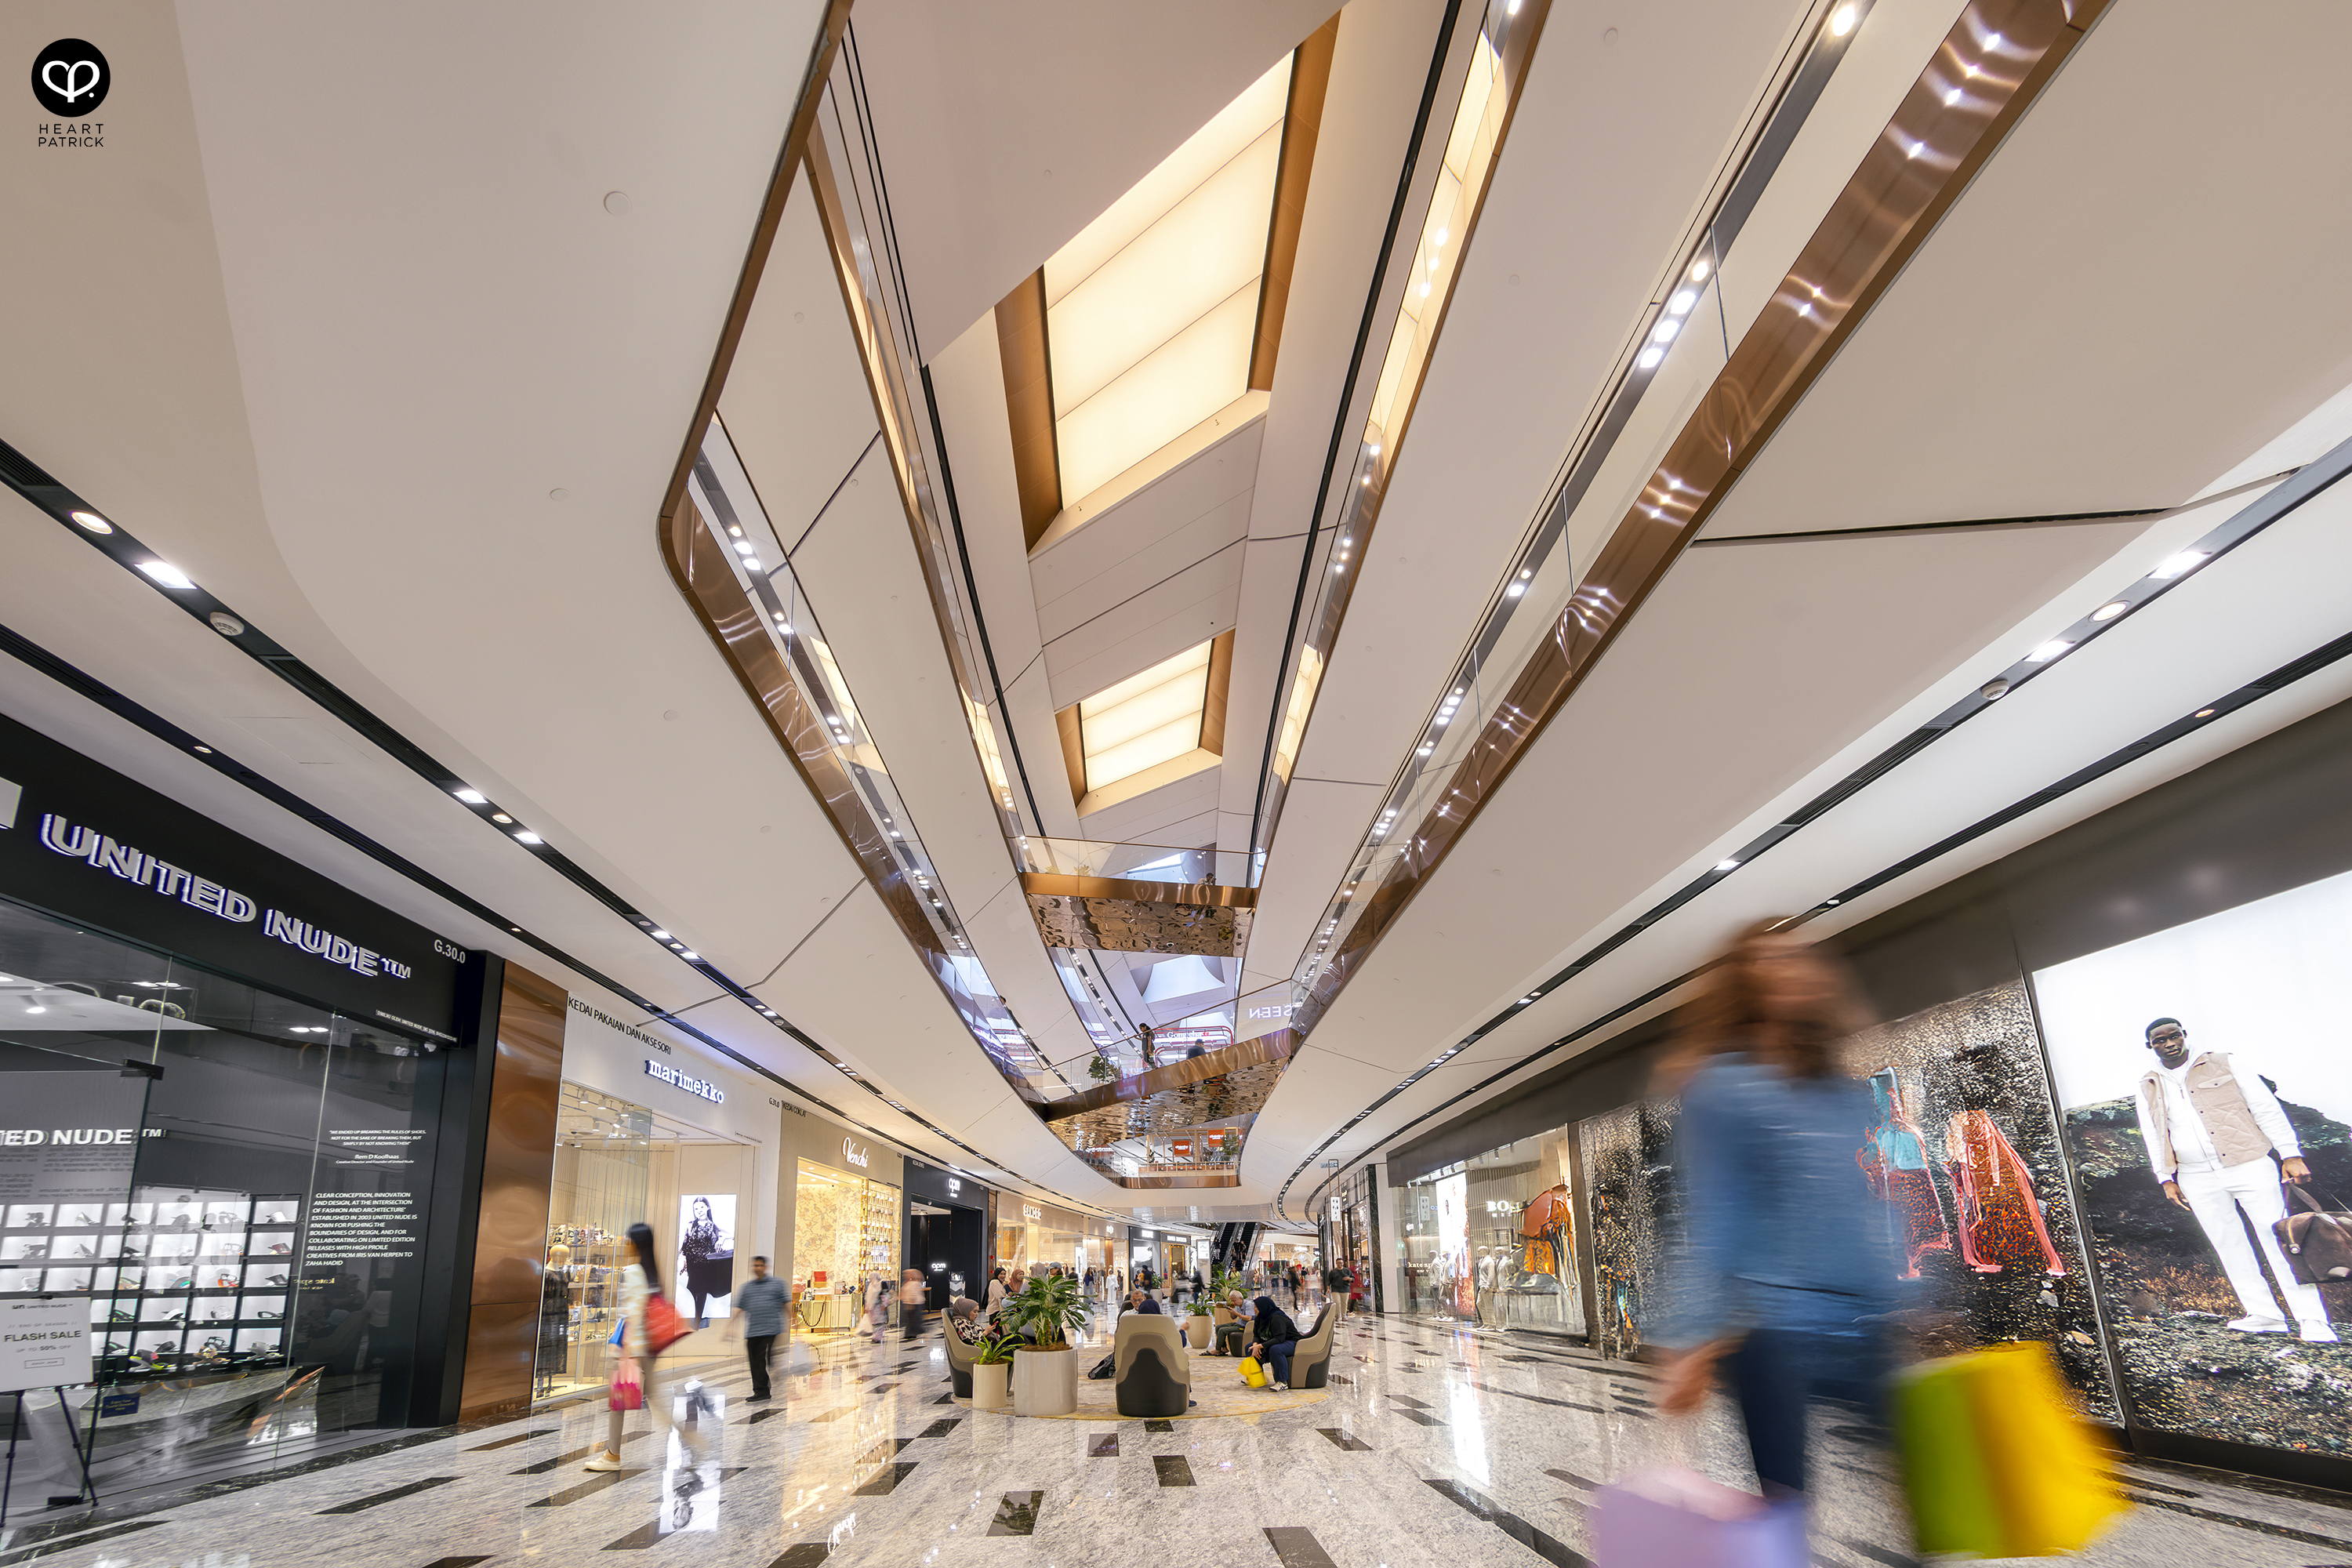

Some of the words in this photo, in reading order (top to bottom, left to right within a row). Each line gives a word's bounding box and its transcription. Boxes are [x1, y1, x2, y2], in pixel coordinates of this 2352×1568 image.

[41, 813, 257, 923] UNITED
[263, 909, 379, 976] NUDE
[434, 938, 466, 964] G.30.0
[568, 996, 593, 1017] KEDAI
[593, 1009, 626, 1033] PAKAIAN
[626, 1025, 641, 1040] DAN
[641, 1033, 672, 1055] AKSESORI
[644, 1060, 724, 1104] marimekko
[51, 1129, 134, 1145] NUDE
[842, 1137, 869, 1168] Venchi
[4, 1332, 47, 1342] FLASH
[49, 1330, 82, 1340] SALE
